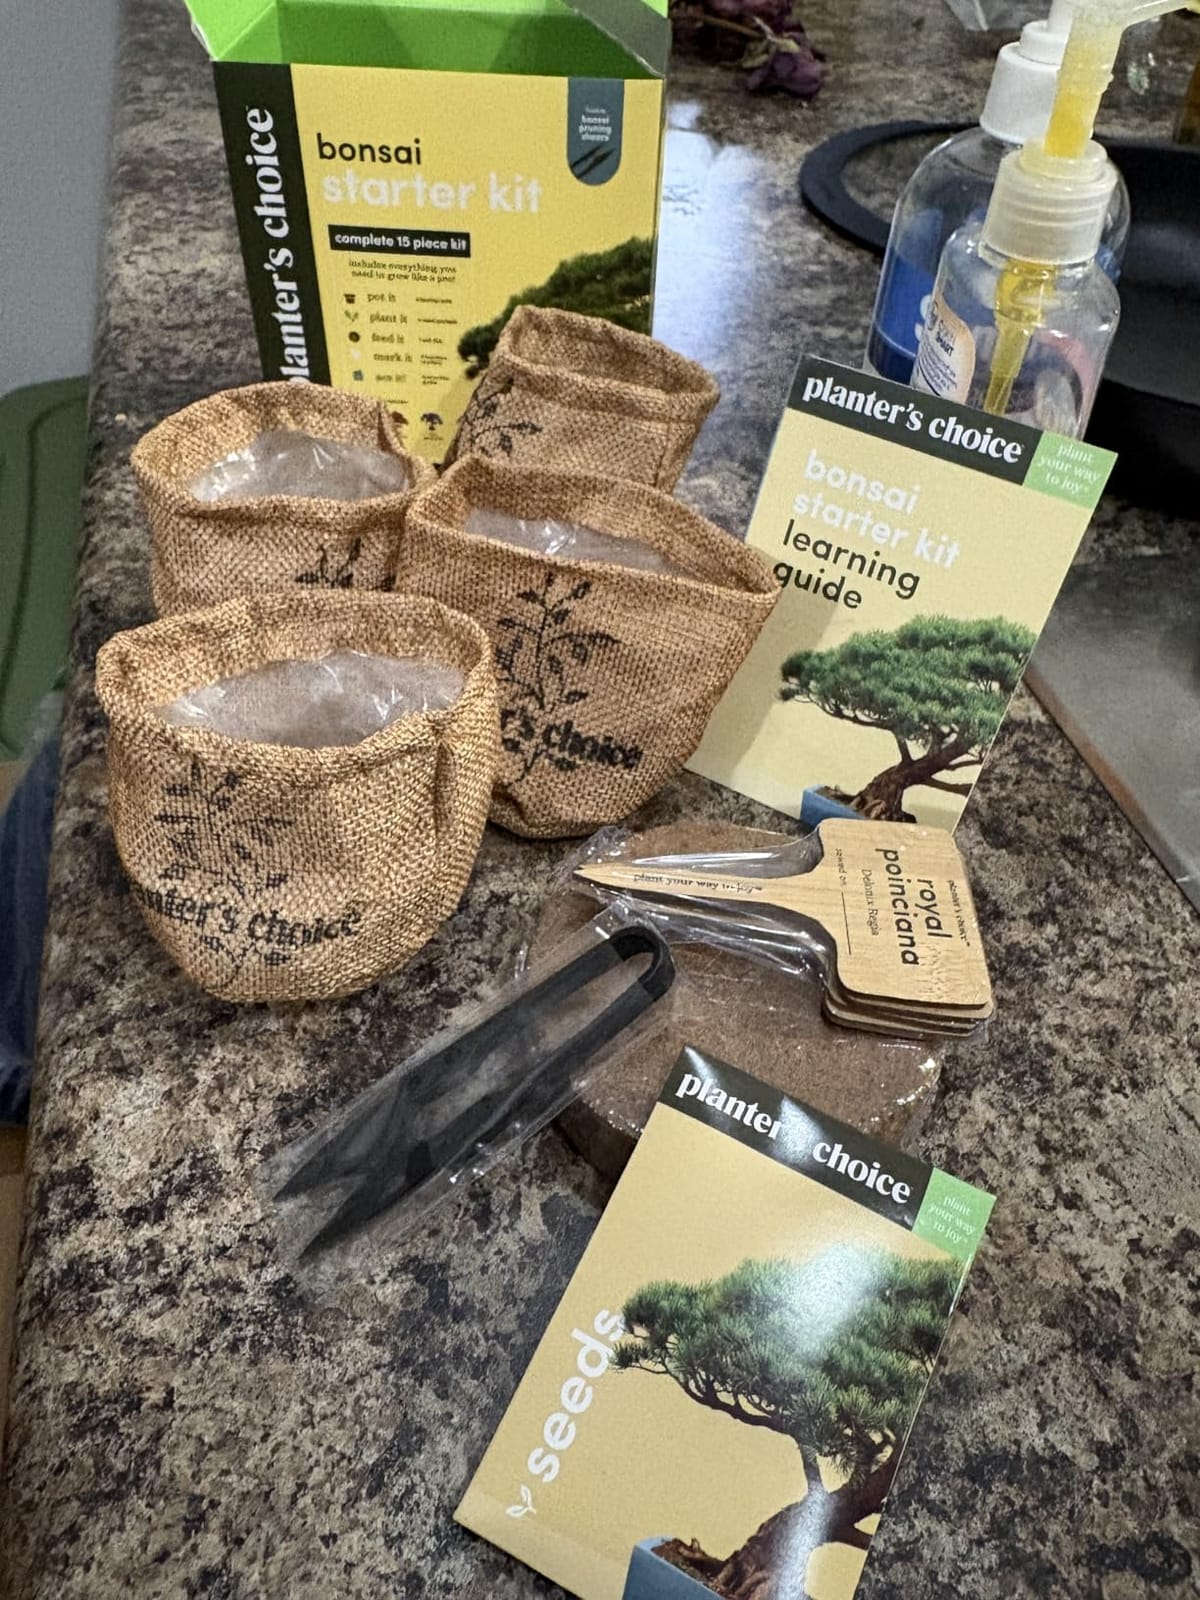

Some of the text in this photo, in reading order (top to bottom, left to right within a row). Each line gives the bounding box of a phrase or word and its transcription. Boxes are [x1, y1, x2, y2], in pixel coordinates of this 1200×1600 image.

[245, 108, 290, 238] choice
[316, 132, 422, 165] bonsai
[322, 168, 543, 213] starter kit
[334, 232, 467, 251] complete 15 piece kit
[802, 377, 1023, 464] planter's choice
[804, 448, 922, 515] bonsai
[1037, 456, 1073, 472] your
[1046, 472, 1060, 485] to
[1056, 444, 1093, 463] plant
[782, 519, 921, 600] learning
[793, 491, 961, 569] starter kit
[773, 561, 862, 609] guide
[875, 848, 920, 966] poinciana
[915, 879, 953, 938] royal
[812, 1140, 912, 1205] choice
[943, 1196, 970, 1216] plant
[527, 1308, 626, 1483] seeds
